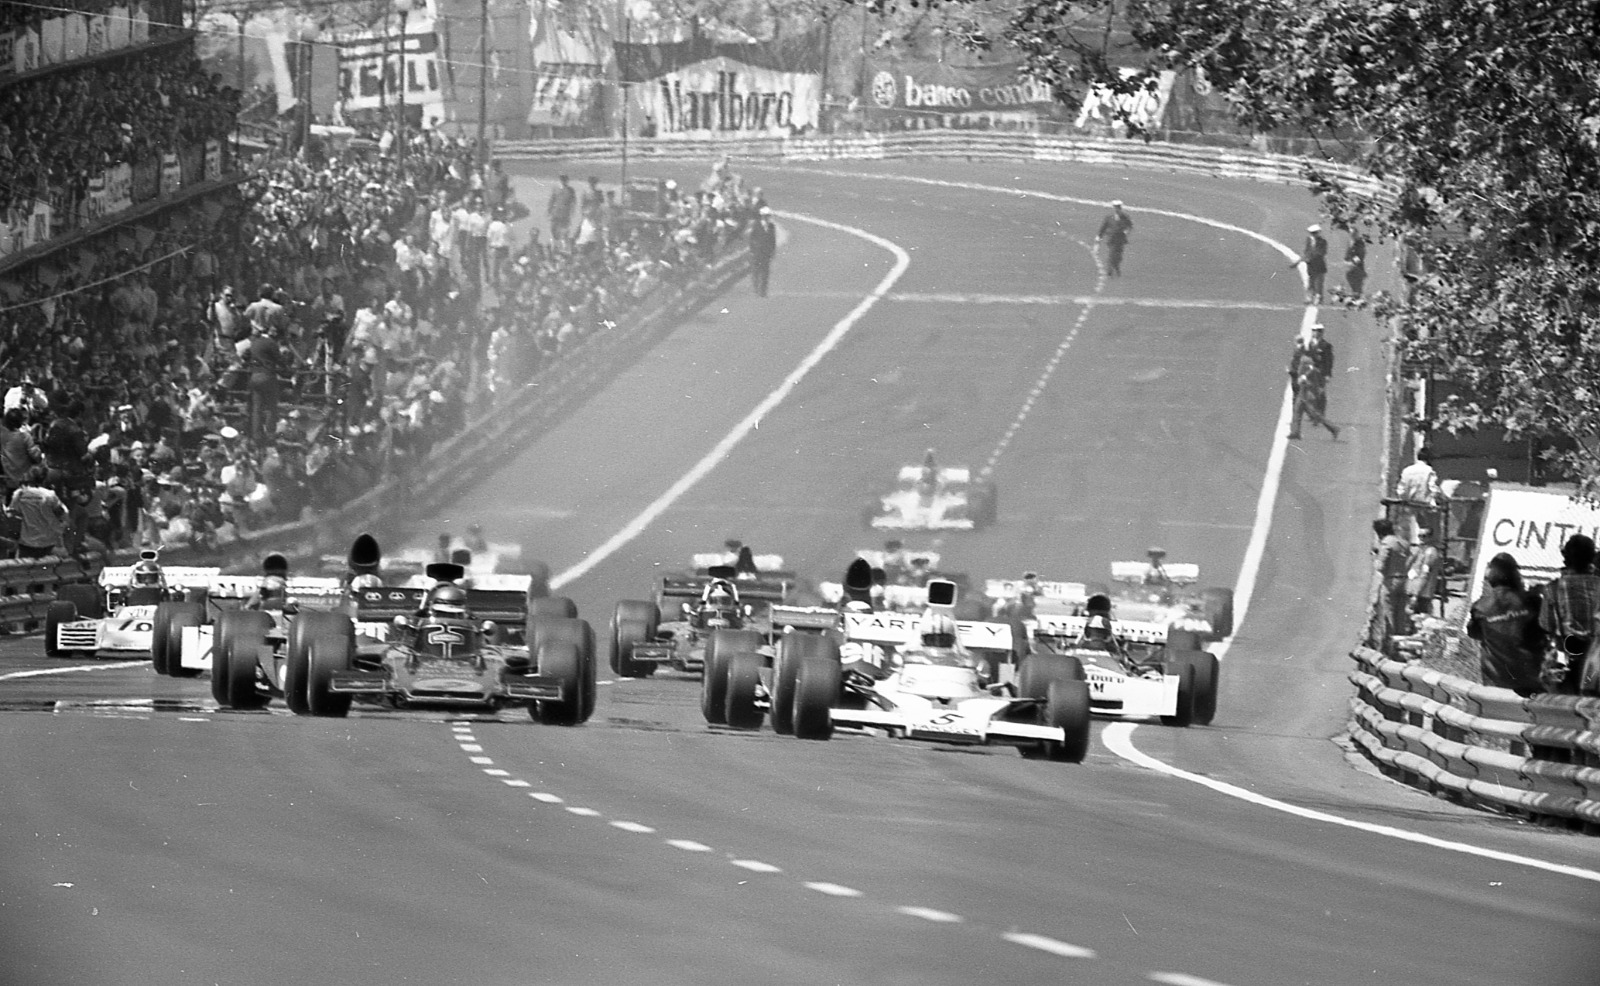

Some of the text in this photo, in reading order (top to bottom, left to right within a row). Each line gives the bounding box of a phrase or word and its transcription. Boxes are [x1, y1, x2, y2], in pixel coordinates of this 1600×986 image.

[660, 69, 793, 132] Marlboro
[905, 75, 972, 108] banco
[979, 74, 1053, 106] conda
[1492, 518, 1600, 549] CINT
[851, 617, 1003, 637] YAREY
[929, 713, 965, 726] 5
